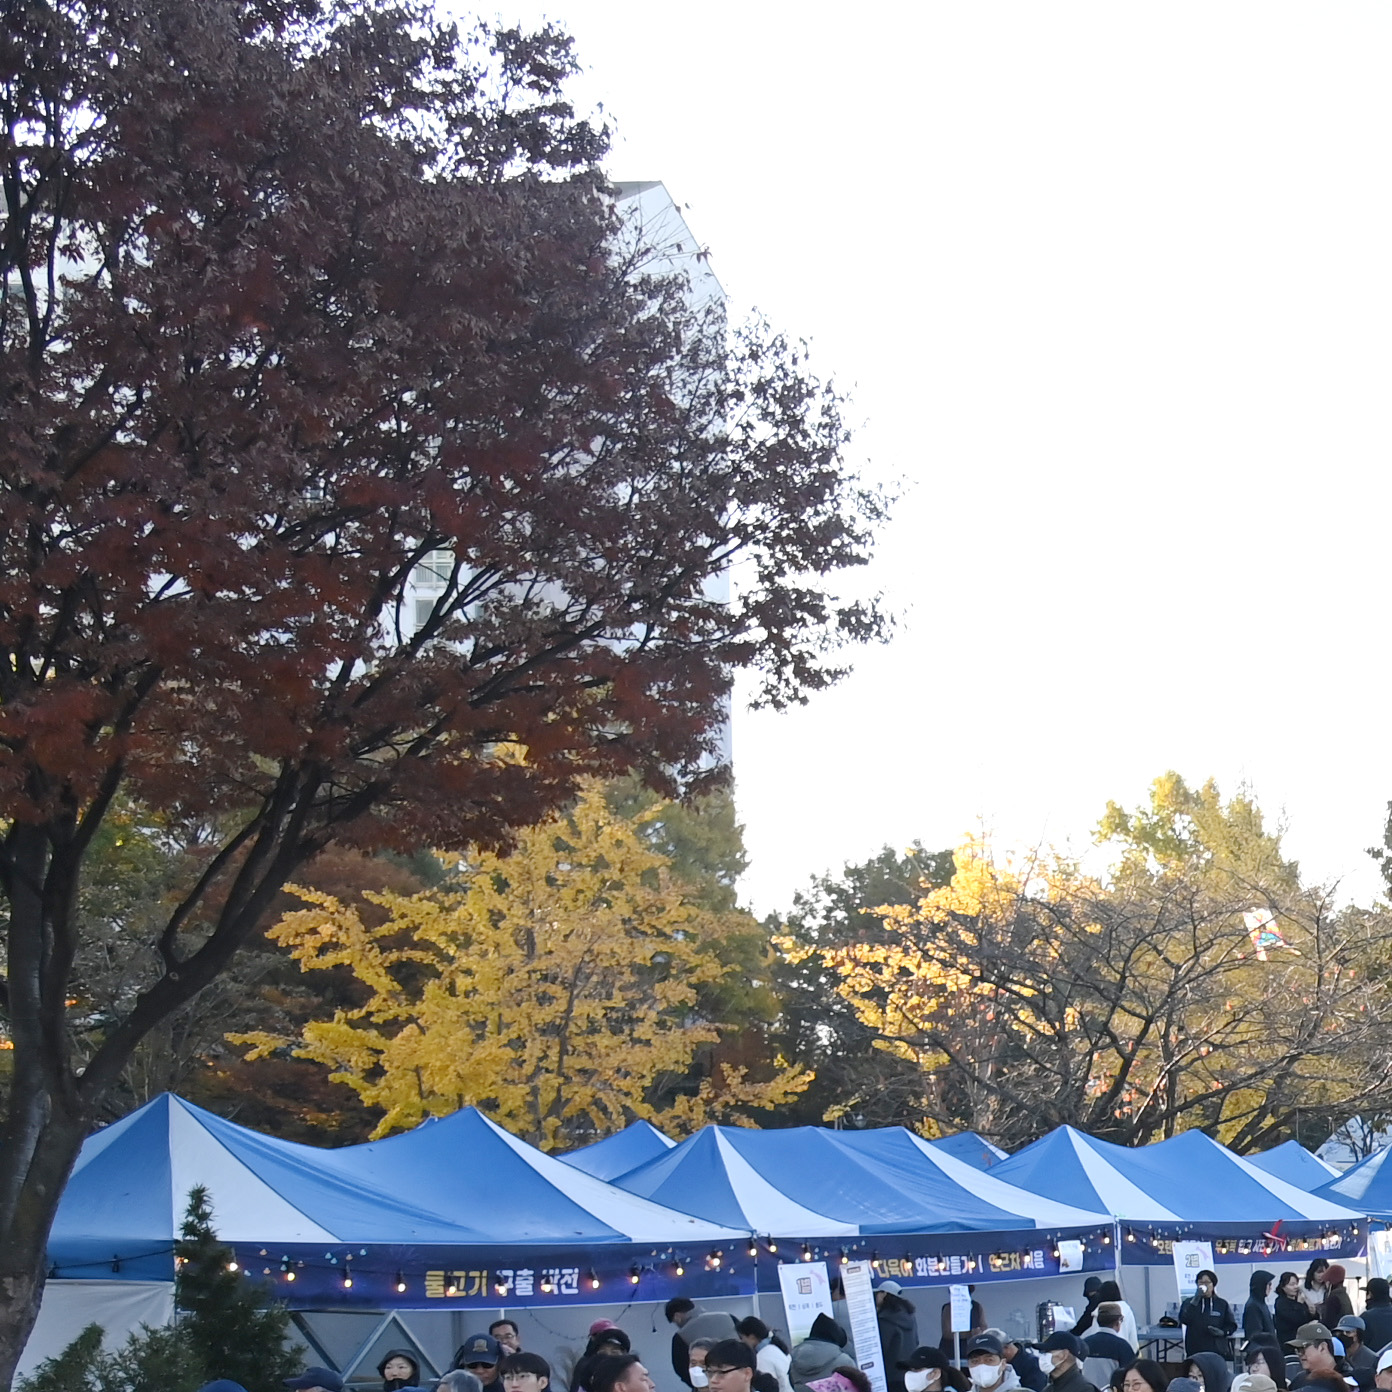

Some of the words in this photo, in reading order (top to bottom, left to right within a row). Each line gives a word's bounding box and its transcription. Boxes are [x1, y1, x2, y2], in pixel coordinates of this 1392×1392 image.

[877, 1258, 914, 1278] 다육이
[425, 1270, 488, 1298] 물고기
[495, 1269, 535, 1297] 구출
[541, 1268, 579, 1295] 작전
